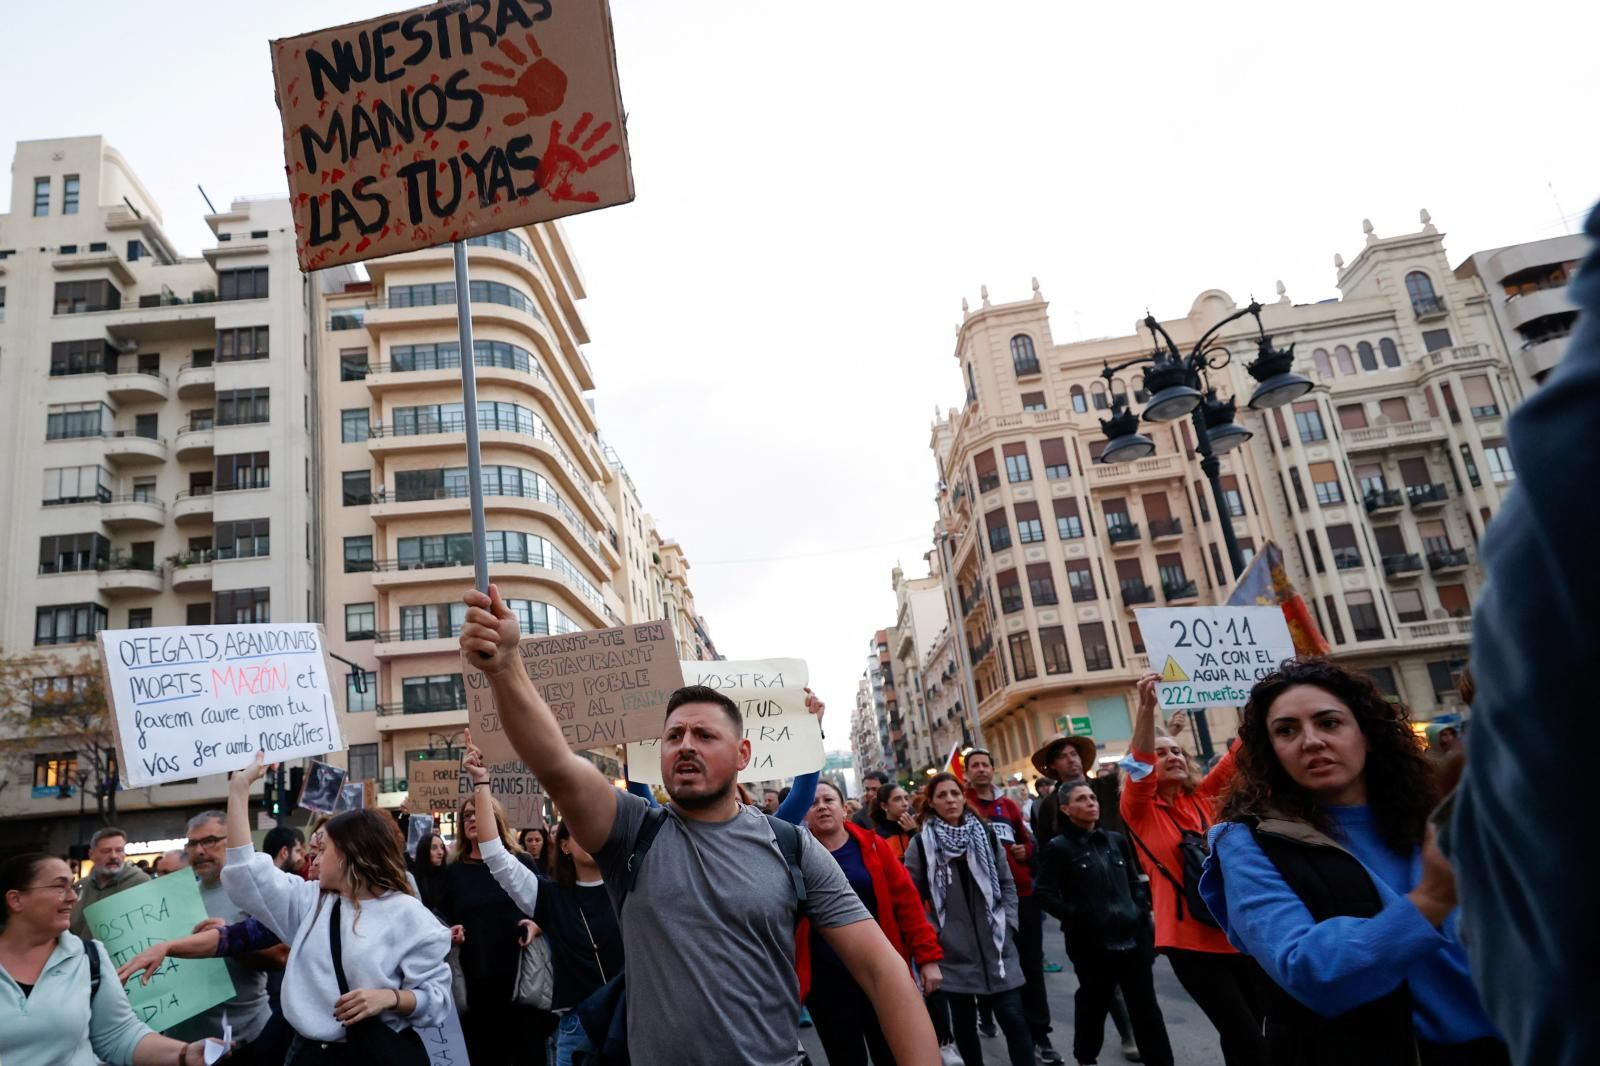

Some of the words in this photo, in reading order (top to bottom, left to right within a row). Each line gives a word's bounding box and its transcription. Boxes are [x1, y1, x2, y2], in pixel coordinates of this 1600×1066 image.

[300, 69, 484, 173] MANOS
[308, 175, 390, 247] LAS
[397, 134, 541, 225] TUYAS
[224, 630, 317, 657] ABANDONATS
[634, 625, 665, 643] EN
[1169, 616, 1257, 648] 20:11
[525, 645, 655, 680] ESTAURANT
[1195, 653, 1219, 667] YA
[1221, 650, 1250, 665] CON
[1255, 650, 1275, 663] EL
[129, 673, 209, 703] MORTS.
[296, 664, 318, 688] et
[582, 668, 651, 697] POBLE
[1193, 669, 1230, 683] AGUA
[1234, 668, 1251, 681] AL
[587, 696, 615, 717] AL
[1162, 686, 1196, 705] 222
[135, 710, 194, 750] farem
[248, 703, 284, 721] com
[287, 695, 312, 715] tu
[561, 712, 627, 745] EDAVÍ
[193, 739, 222, 768] fer
[225, 734, 254, 755] amb
[433, 769, 459, 781] POBLE
[489, 777, 525, 795] ANOS
[419, 786, 449, 797] SALVA
[429, 798, 458, 810] POBLE
